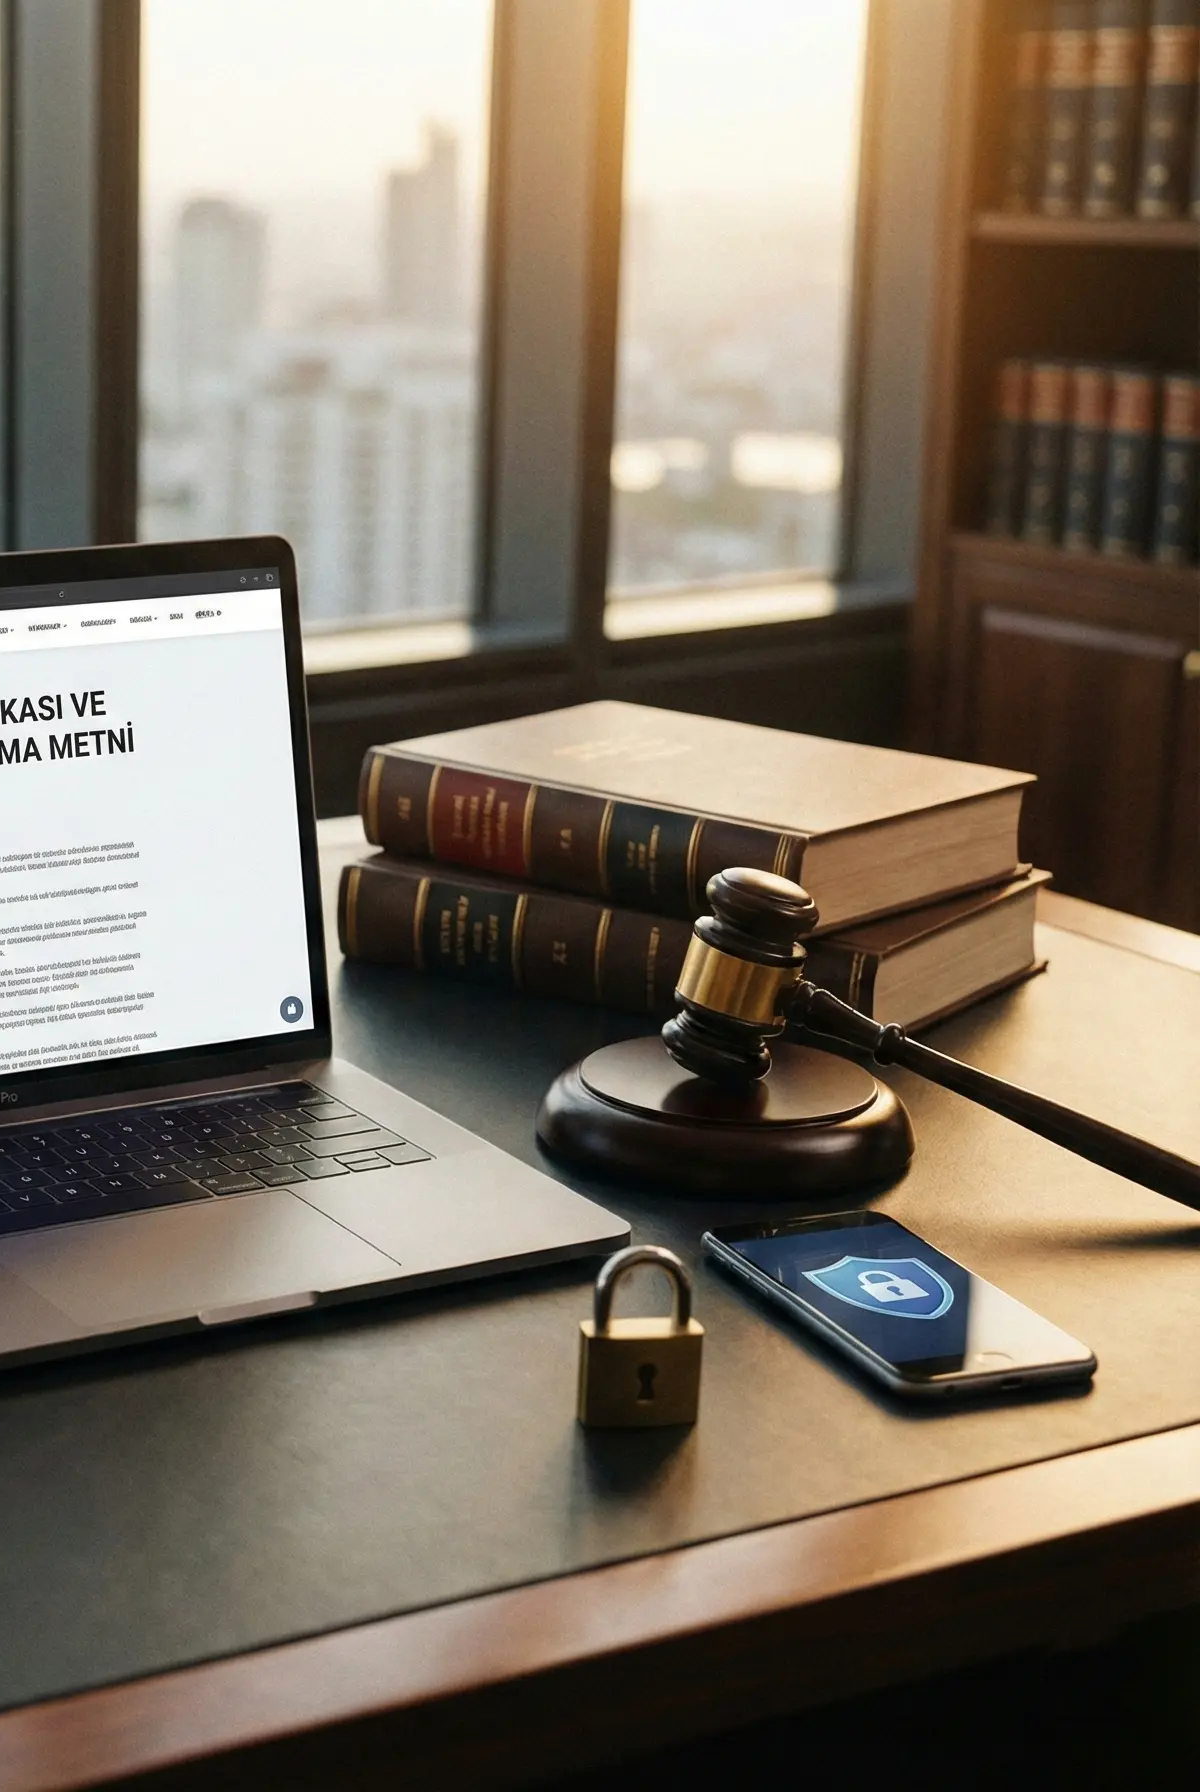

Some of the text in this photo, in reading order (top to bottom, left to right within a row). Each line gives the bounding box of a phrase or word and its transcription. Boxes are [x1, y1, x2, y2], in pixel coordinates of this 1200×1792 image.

[69, 690, 107, 717] VE
[49, 721, 136, 760] METNİ
[1, 1091, 19, 1104] Pro
